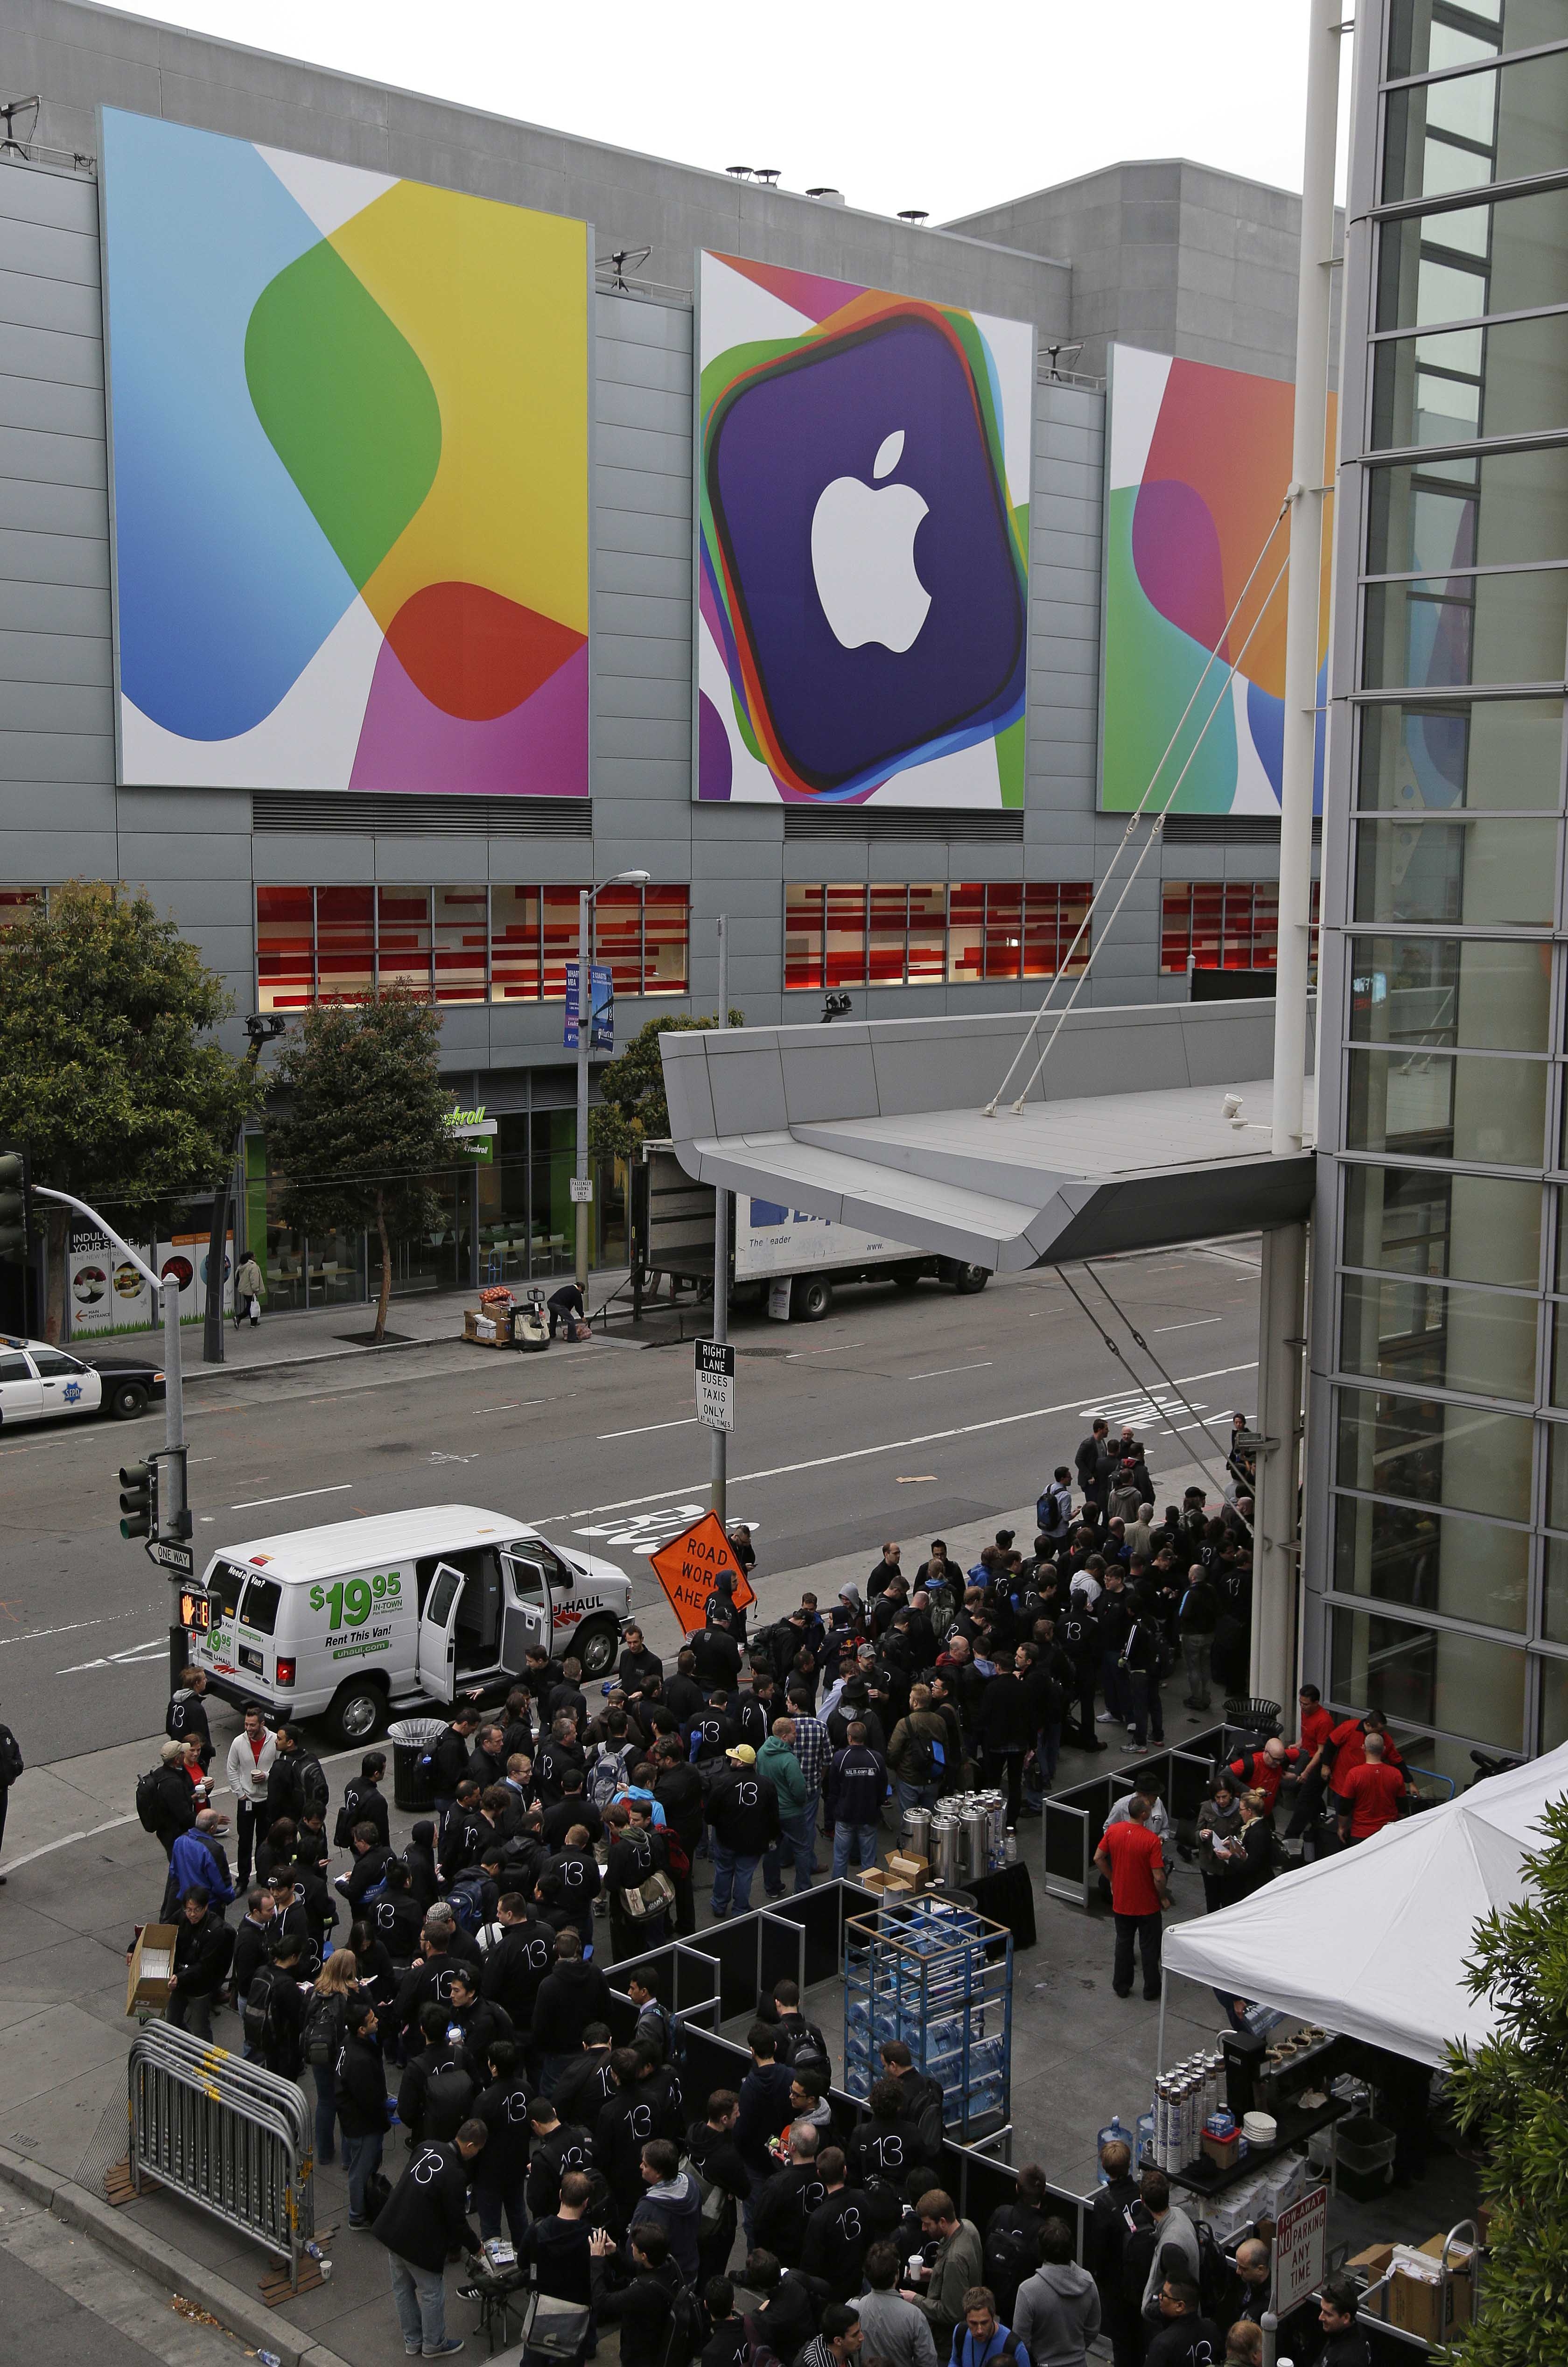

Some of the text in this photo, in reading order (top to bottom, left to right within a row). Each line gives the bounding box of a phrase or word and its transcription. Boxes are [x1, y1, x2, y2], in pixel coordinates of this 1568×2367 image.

[73, 1232, 109, 1243] INDULG
[73, 1242, 101, 1253] YOUR
[750, 1236, 791, 1247] The eader
[703, 1345, 726, 1359] RIGHT
[704, 1358, 725, 1372] LANE
[701, 1372, 728, 1387] BUSES
[703, 1387, 726, 1402] TAXIS
[704, 1404, 724, 1418] ONLY
[158, 1547, 188, 1565] ONE WAY
[687, 1538, 728, 1566] ROAD
[1201, 1547, 1211, 1565] 13
[228, 1566, 241, 1579] Need
[251, 1576, 266, 1588] Van?
[994, 1577, 1008, 1597] 13
[1226, 1578, 1239, 1596] 13
[373, 1599, 403, 1611] IN-TOWN
[673, 1585, 707, 1611] AHE
[325, 1625, 392, 1647] Rent This Van!
[945, 1623, 959, 1643] 13
[1065, 1621, 1081, 1640] 13
[214, 1653, 232, 1667] U-HAUL
[337, 1642, 385, 1657] uhaul.com
[172, 1704, 185, 1728] 13
[699, 1721, 720, 1742] 13
[542, 1754, 553, 1779] 13
[735, 1782, 758, 1806] 13
[560, 1862, 583, 1885] 13
[376, 1903, 395, 1928] 13
[522, 1939, 547, 1970] 13
[502, 2092, 526, 2123] 13
[623, 2105, 651, 2140] 13
[872, 2135, 903, 2167] 13
[410, 2148, 443, 2184] 13
[1281, 2193, 1322, 2229] TOW-AWAY
[836, 2207, 861, 2240] 13
[1279, 2210, 1324, 2256] NO PARKING
[1292, 2241, 1310, 2268] ANY
[1291, 2260, 1311, 2288] TIME
